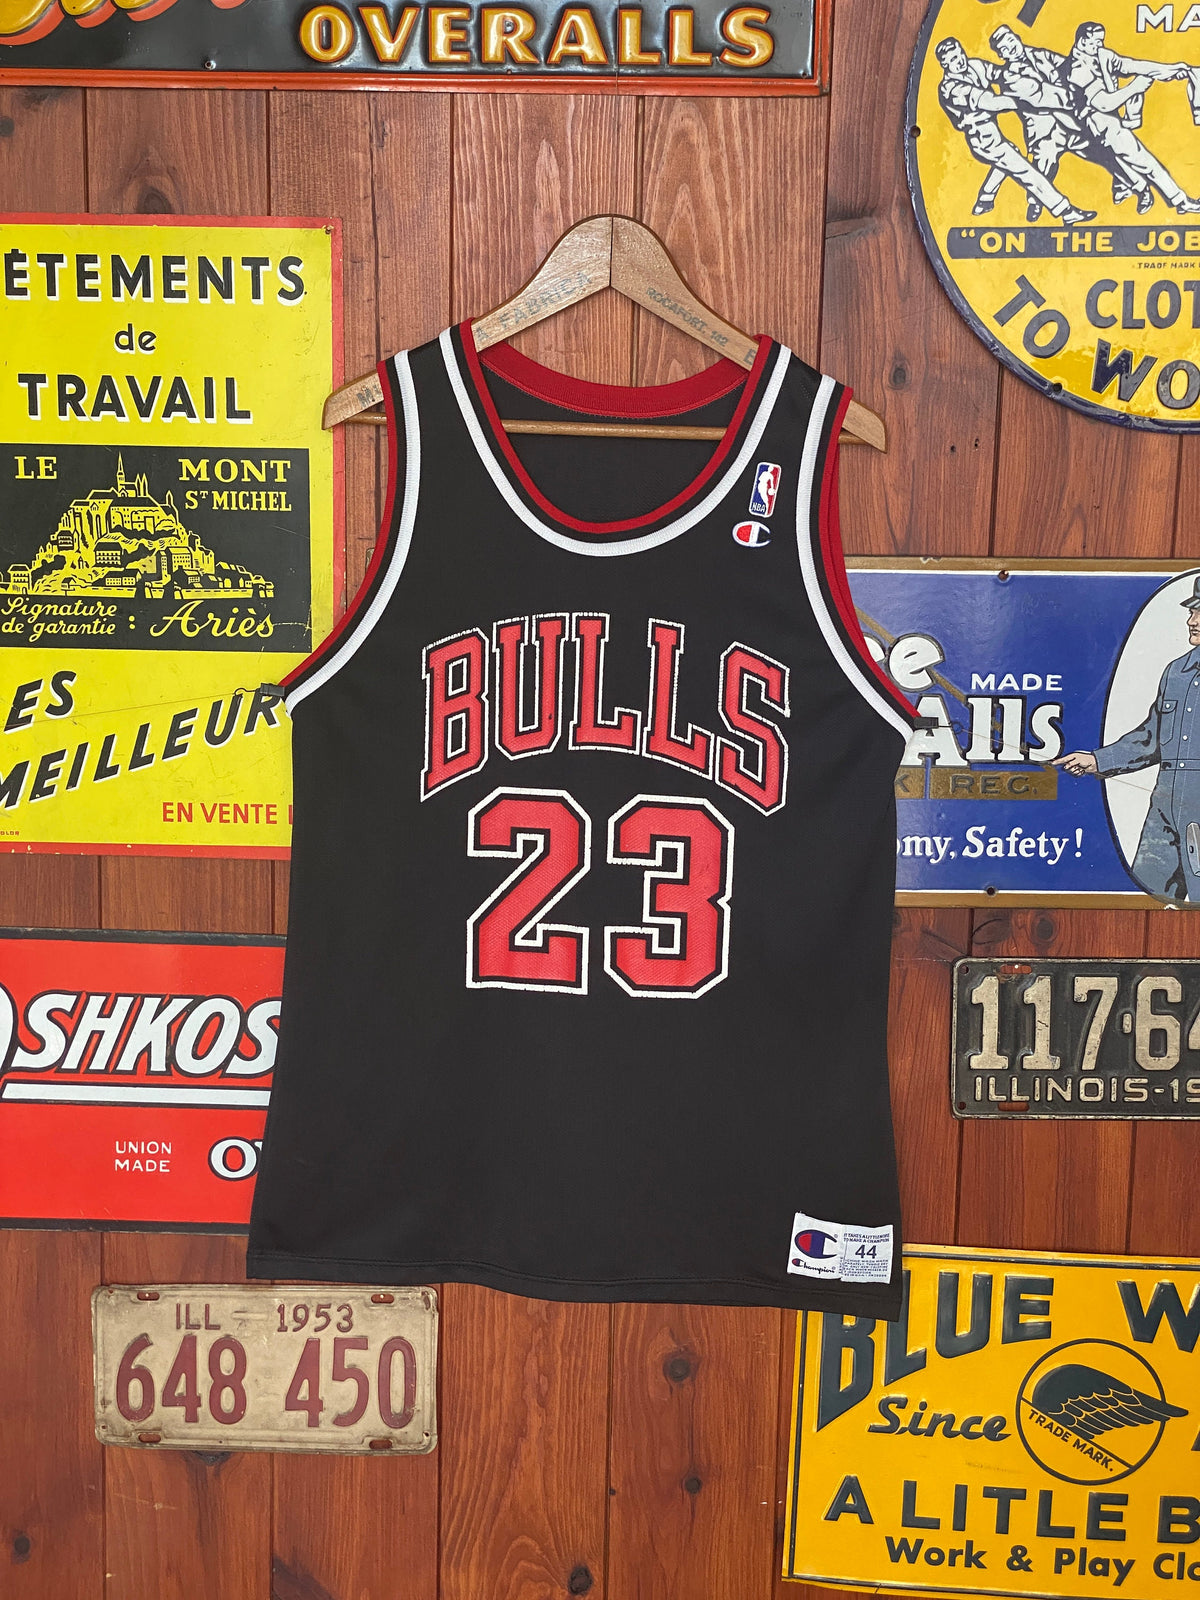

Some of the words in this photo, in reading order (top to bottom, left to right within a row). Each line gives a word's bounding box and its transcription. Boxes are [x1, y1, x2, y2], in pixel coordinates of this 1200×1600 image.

[299, 5, 775, 69] OVERALLS
[1050, 231, 1113, 252] THE
[993, 274, 1071, 360] TO
[114, 323, 157, 352] de
[17, 373, 252, 420] TRAVAIL
[14, 455, 58, 480] LE
[178, 458, 292, 483] MONT
[211, 491, 292, 512] MICHEL
[751, 502, 767, 513] NBA
[1, 596, 118, 624] Signature
[1, 616, 25, 635] de
[29, 616, 116, 643] garantie
[150, 600, 275, 638] Ariès
[971, 673, 1063, 692] MADE
[4, 670, 78, 733] ES
[420, 612, 791, 817] BULLS
[950, 774, 1039, 796] REG.
[162, 802, 193, 823] EN
[200, 802, 278, 825] VENTE
[897, 835, 955, 864] my,
[466, 786, 735, 1000] 23
[0, 983, 284, 1077] SHKOS
[115, 1140, 172, 1155] UNION
[114, 1159, 171, 1173] MADE
[855, 1244, 877, 1259] 44
[175, 1303, 221, 1331] ILL
[276, 1303, 354, 1333] 1953
[116, 1333, 248, 1425] 648
[285, 1336, 418, 1429] 450
[867, 1395, 1012, 1442] Since
[1028, 1408, 1072, 1443] TRADE
[824, 1475, 875, 1525] A
[901, 1480, 1129, 1542] LITLE
[885, 1535, 988, 1569] Work
[1006, 1544, 1034, 1572] &
[1053, 1547, 1136, 1587] Play
